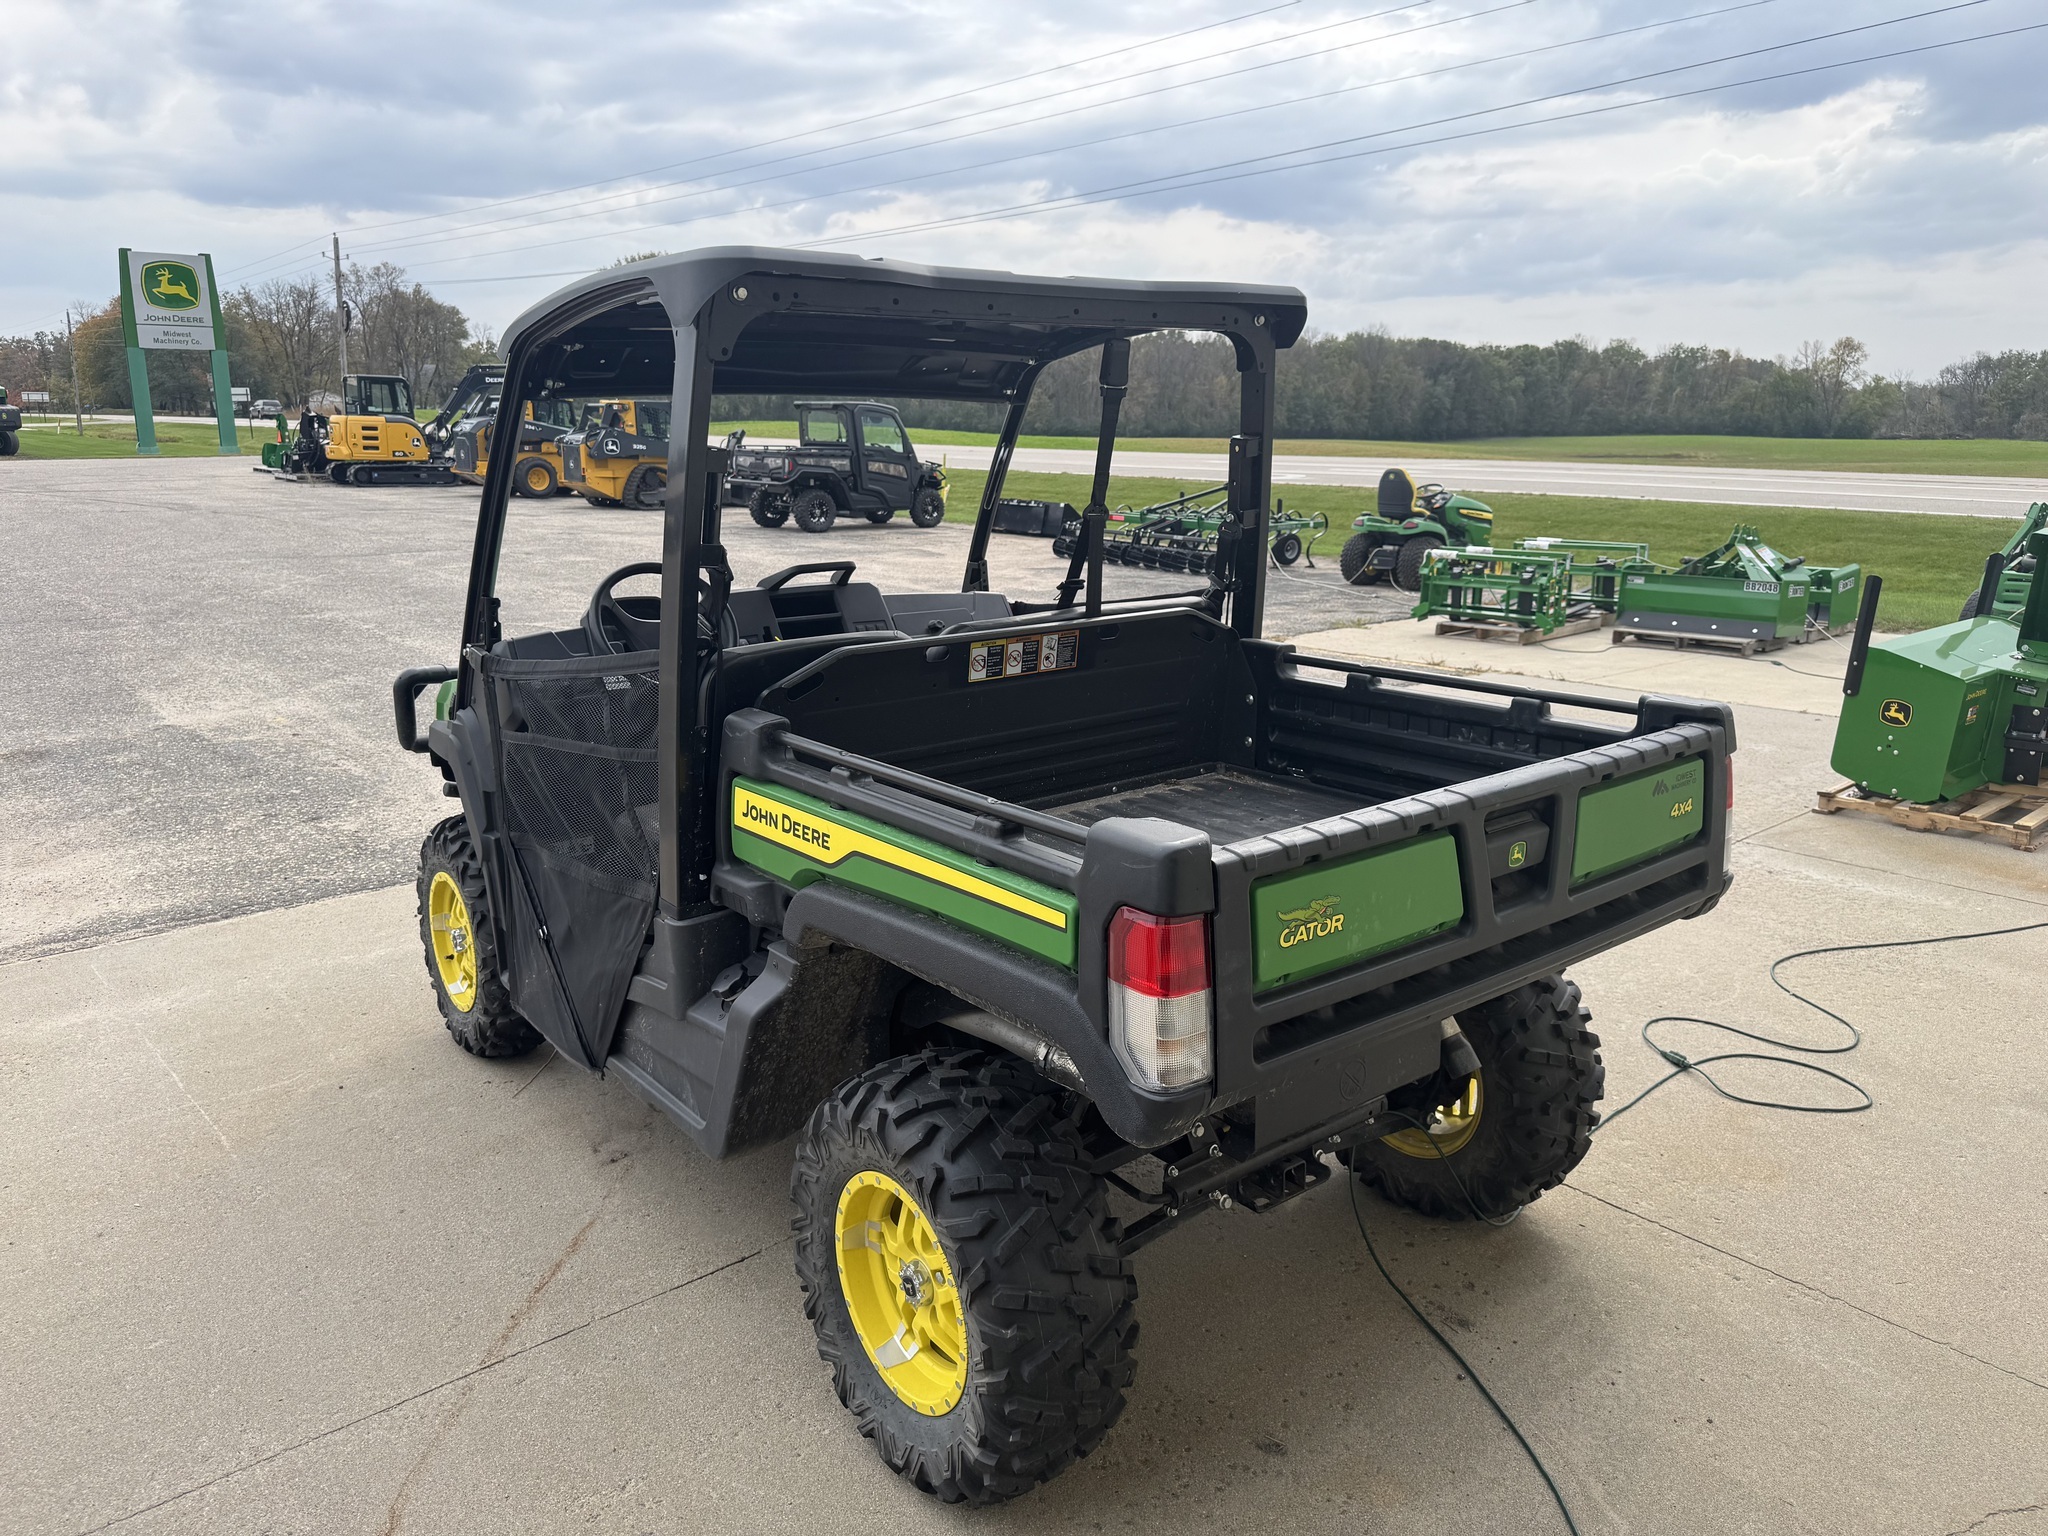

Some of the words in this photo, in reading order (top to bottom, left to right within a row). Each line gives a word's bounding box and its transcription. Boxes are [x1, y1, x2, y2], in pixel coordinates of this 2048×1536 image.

[143, 313, 171, 322] JOHN
[172, 314, 205, 324] DEERE
[162, 330, 192, 338] Midwest
[153, 337, 190, 346] Machinery
[1744, 581, 1779, 593] BB2048
[742, 800, 778, 830] JOHN
[782, 813, 831, 851] DEERE
[1279, 913, 1345, 949] GATOR
